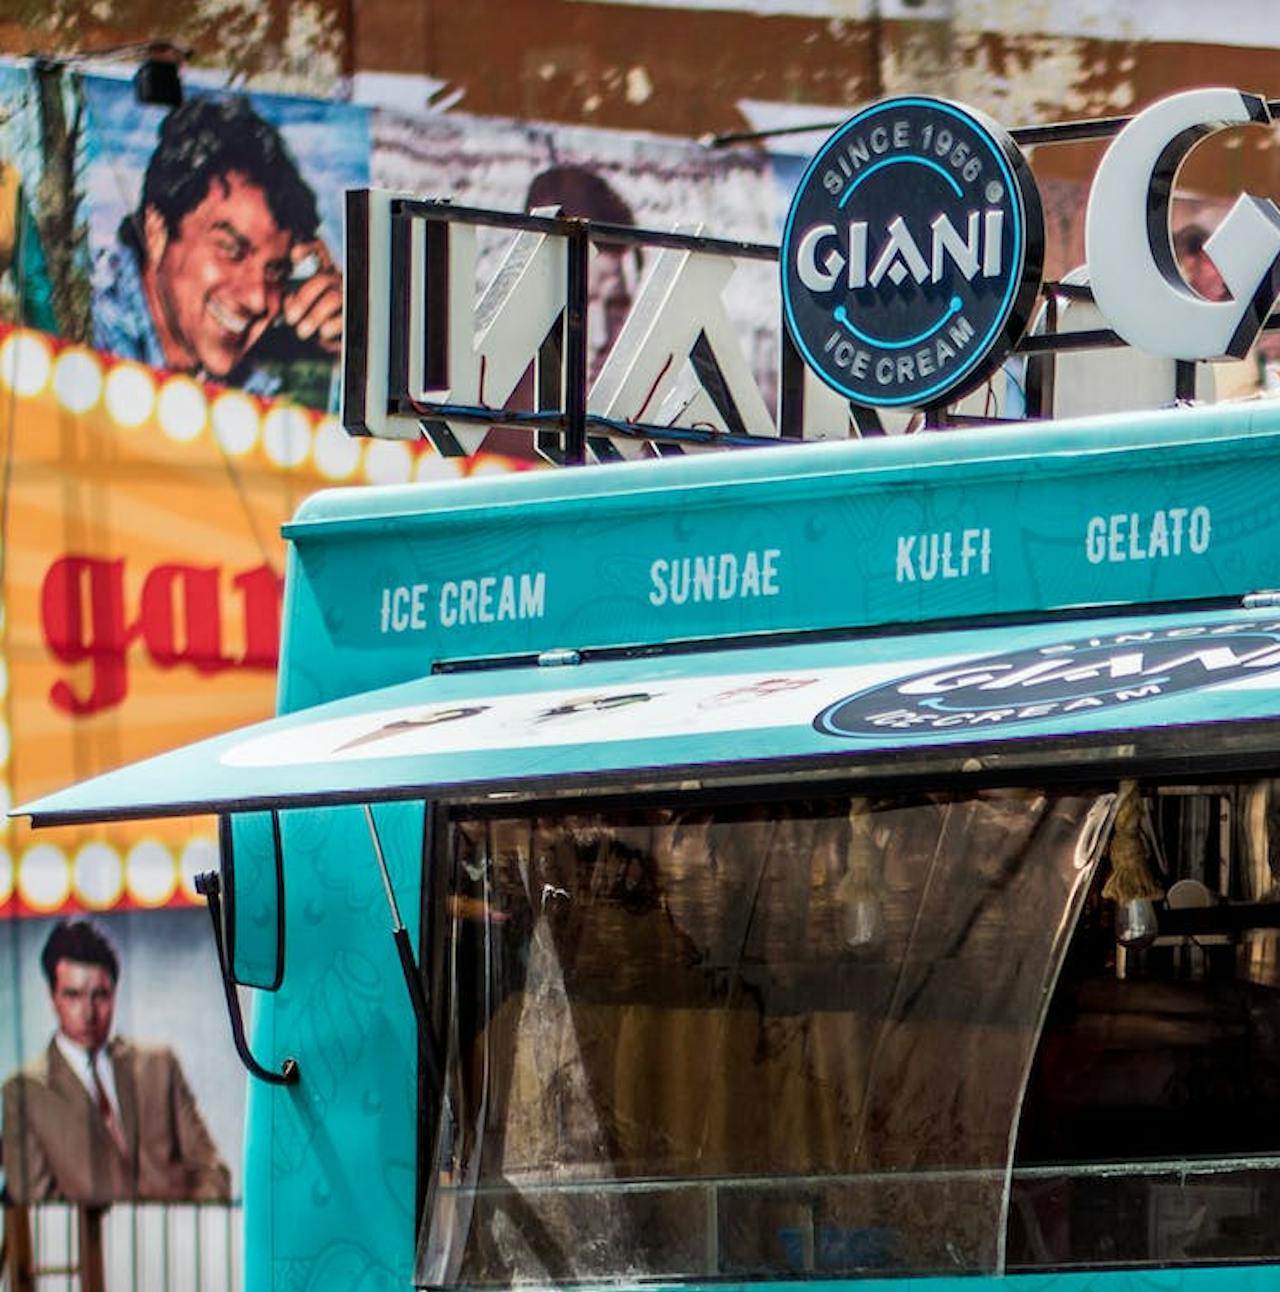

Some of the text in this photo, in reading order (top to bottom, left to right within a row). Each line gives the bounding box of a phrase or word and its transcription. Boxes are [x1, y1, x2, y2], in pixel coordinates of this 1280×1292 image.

[823, 120, 909, 195] SINCE
[796, 209, 1005, 293] GIANI
[823, 316, 976, 385] ICE CREAM
[896, 528, 990, 582] KULFI
[1086, 506, 1211, 563] GELATO
[381, 573, 545, 632] ICE CREAM
[650, 549, 780, 605] SUNDAE
